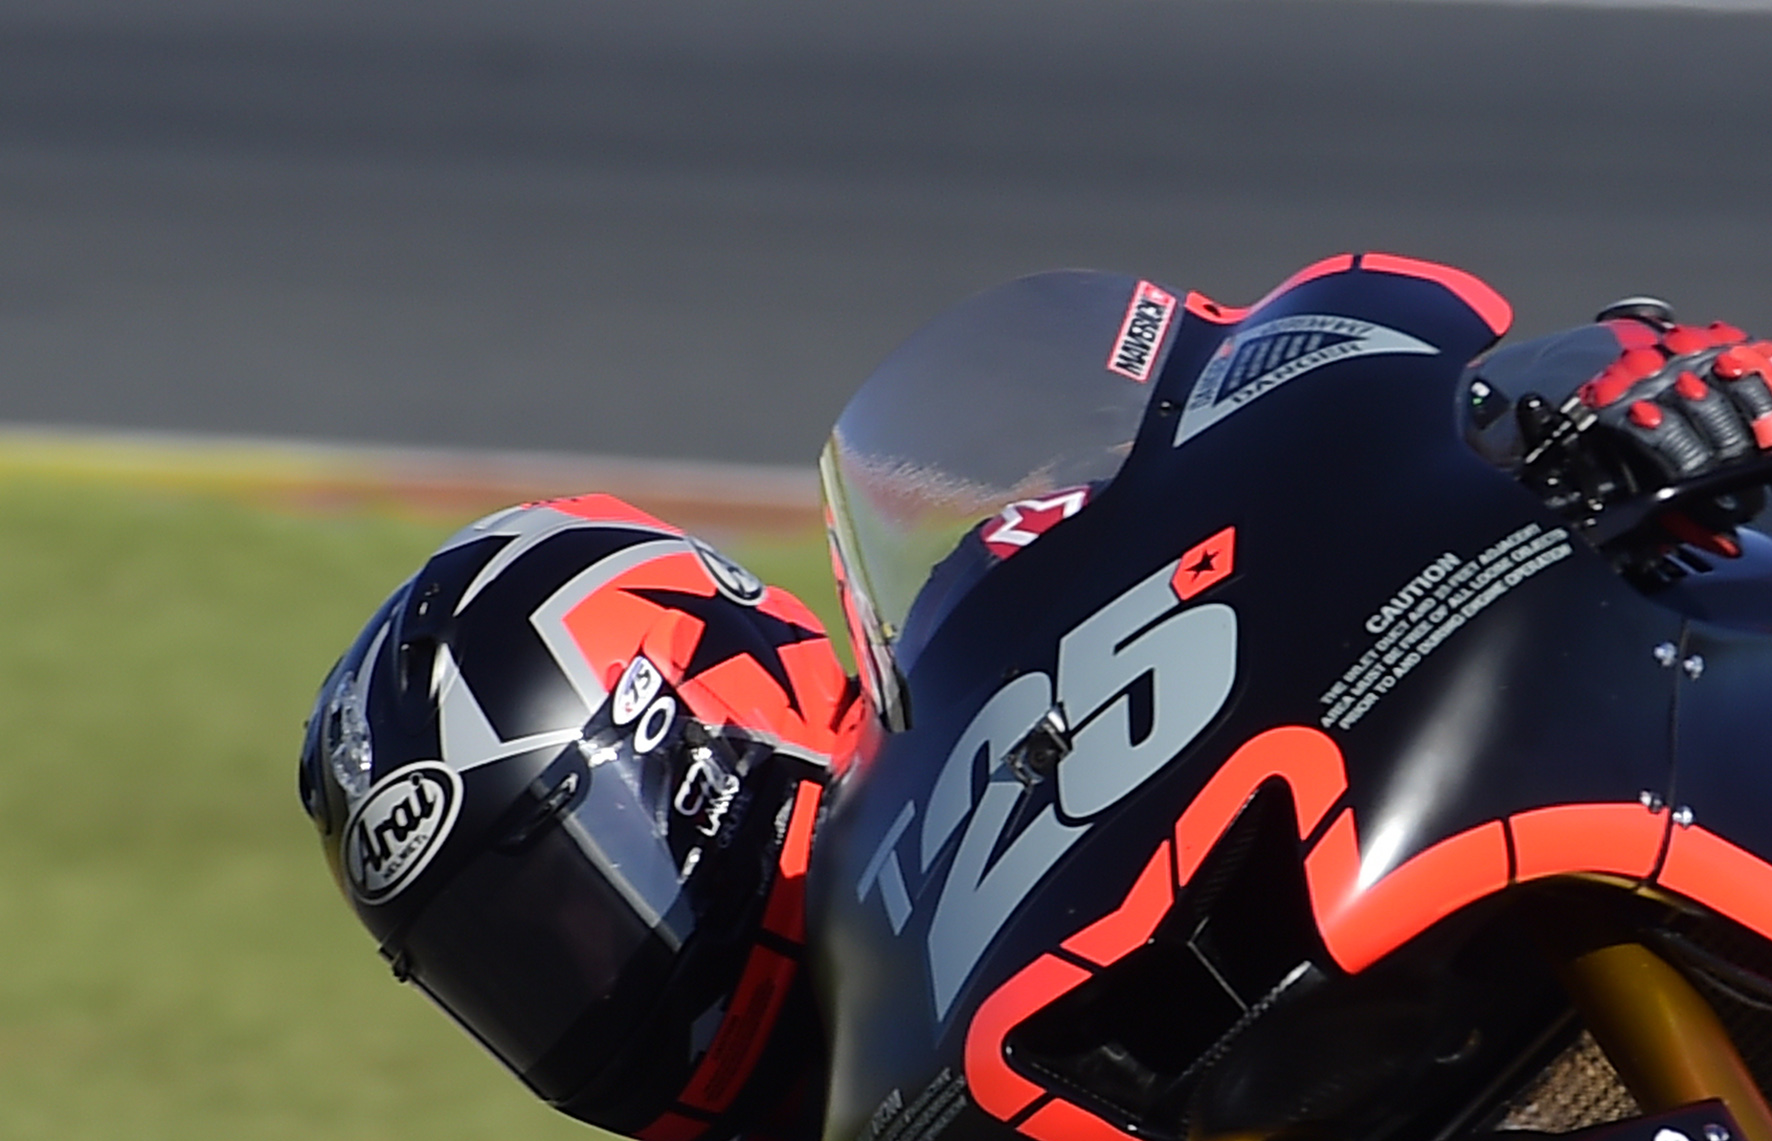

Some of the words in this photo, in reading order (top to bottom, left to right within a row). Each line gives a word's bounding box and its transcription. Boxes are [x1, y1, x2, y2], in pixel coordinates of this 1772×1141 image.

[1231, 341, 1364, 404] DANGER
[1320, 695, 1356, 728] AREA
[1350, 662, 1386, 697] MUST
[1382, 647, 1405, 666] BE
[1399, 620, 1434, 650] FREE
[1429, 604, 1449, 623] OF
[1448, 587, 1475, 609] ALL
[1469, 556, 1515, 590] LOOSE
[1338, 692, 1380, 730] PRIOR
[1374, 675, 1396, 695] TO
[1392, 652, 1422, 678] AND
[1416, 613, 1466, 655] DURING
[1504, 543, 1573, 587] OPERATION
[1365, 552, 1462, 633] CAUTION
[1320, 681, 1348, 704] THE
[1375, 619, 1410, 651] DUCT
[1408, 597, 1437, 623] AND
[358, 772, 438, 889] Arai
